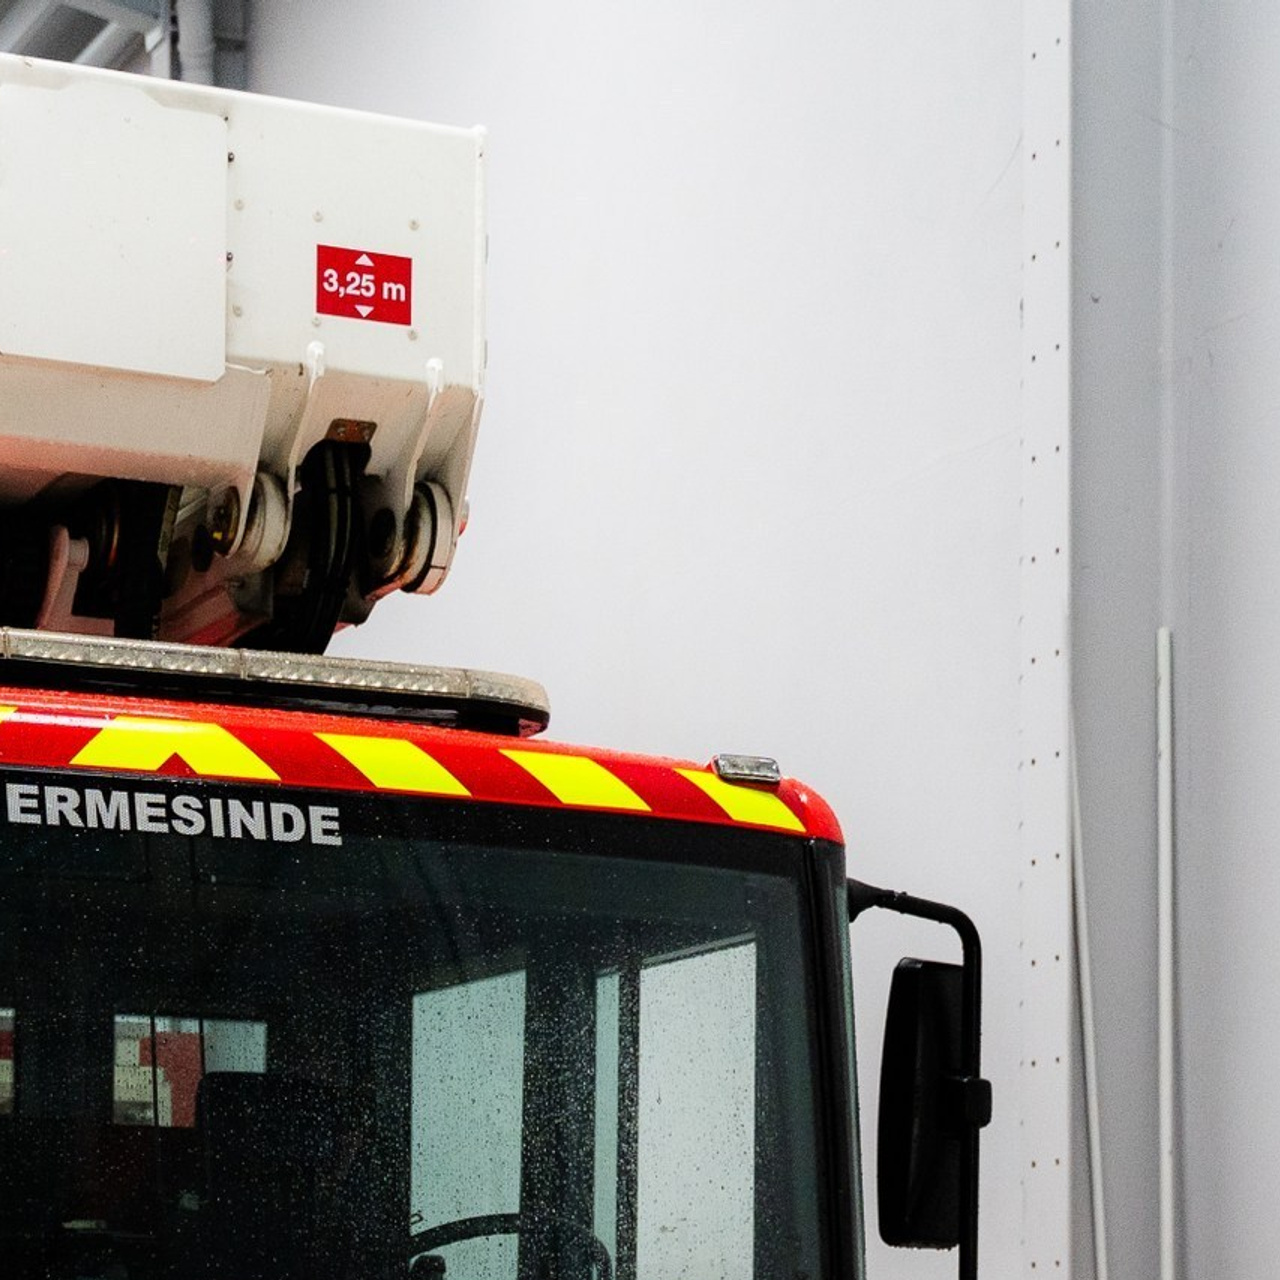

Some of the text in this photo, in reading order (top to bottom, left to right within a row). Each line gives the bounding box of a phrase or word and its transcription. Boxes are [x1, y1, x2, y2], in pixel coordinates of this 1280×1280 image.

[322, 267, 406, 302] 3,25 m
[5, 782, 343, 846] ERMESINDE
